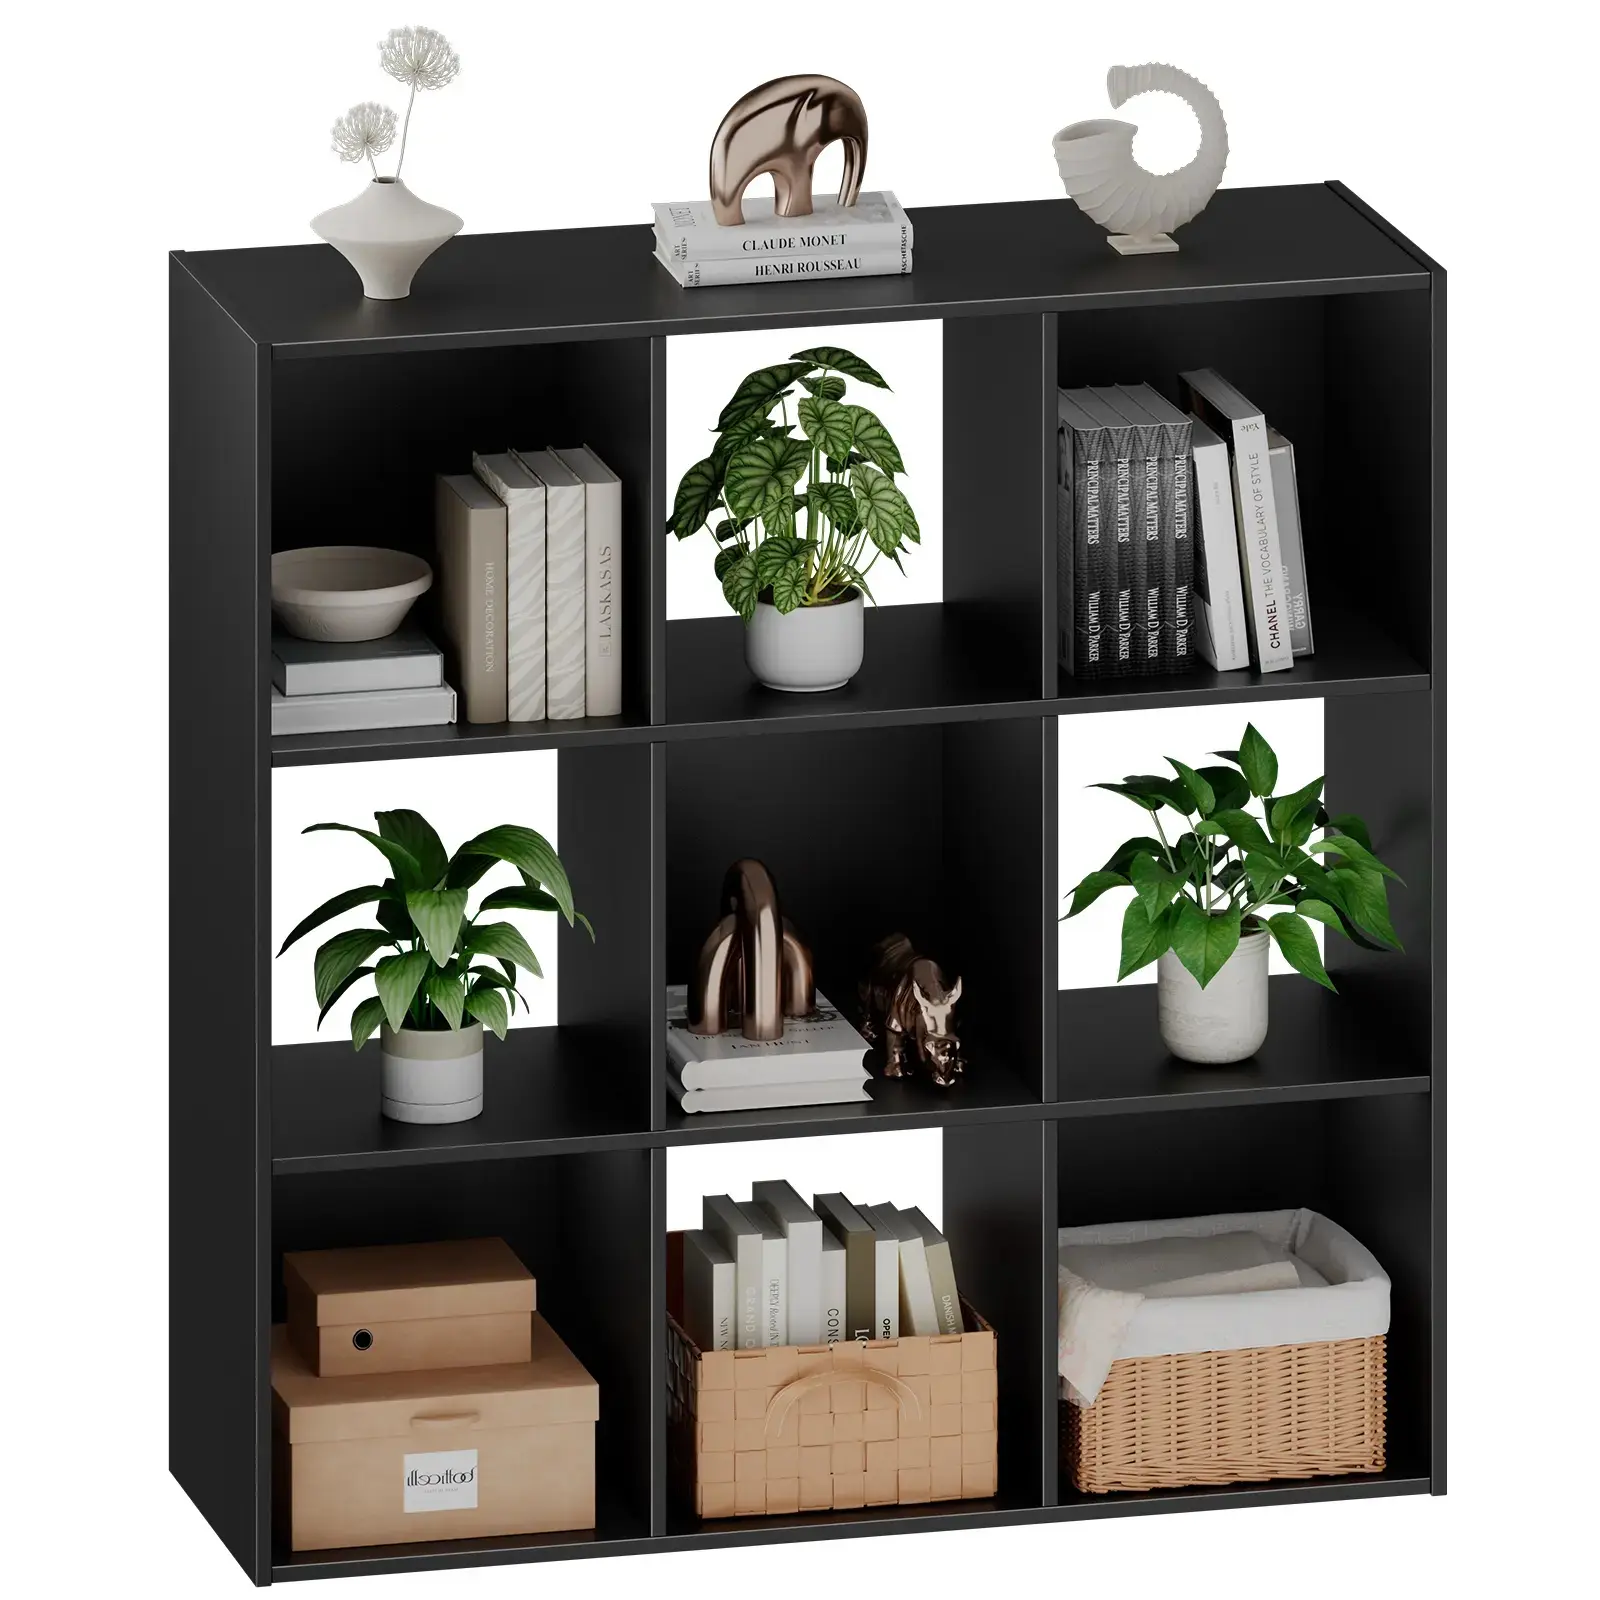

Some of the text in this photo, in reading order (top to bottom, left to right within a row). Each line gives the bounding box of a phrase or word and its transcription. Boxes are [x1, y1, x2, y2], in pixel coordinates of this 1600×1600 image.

[742, 233, 848, 252] CLAUDE MONET
[754, 258, 863, 277] HENRI ROUSSEAU
[1240, 422, 1260, 433] Yale
[1248, 452, 1262, 485] STYLE
[1087, 460, 1100, 545] PRINCIPAL MATTERS
[1117, 458, 1130, 543] PRINCIPAL MATTERS
[1146, 456, 1159, 541] PRINCIPAL MATTERS
[1174, 454, 1188, 539] PRINCIPAL MATTERS
[1253, 487, 1264, 502] OF
[1254, 504, 1272, 576] VOCABULARY
[599, 545, 612, 639] LASKASAS
[1147, 587, 1160, 621] WILLIAM
[1176, 585, 1188, 619] WILLIAM
[1263, 577, 1274, 598] THE
[485, 561, 495, 673] HOME DECORATION
[1088, 591, 1101, 624] WILLIAM
[1118, 589, 1131, 623] WILLIAM
[1265, 599, 1281, 649] CHANEL
[1088, 635, 1101, 663] PARKER
[1118, 633, 1131, 661] PARKER
[1147, 631, 1160, 659] PARKER
[1176, 629, 1188, 657] PARKER
[745, 1286, 757, 1332] GRAND
[941, 1294, 955, 1327] DANISH
